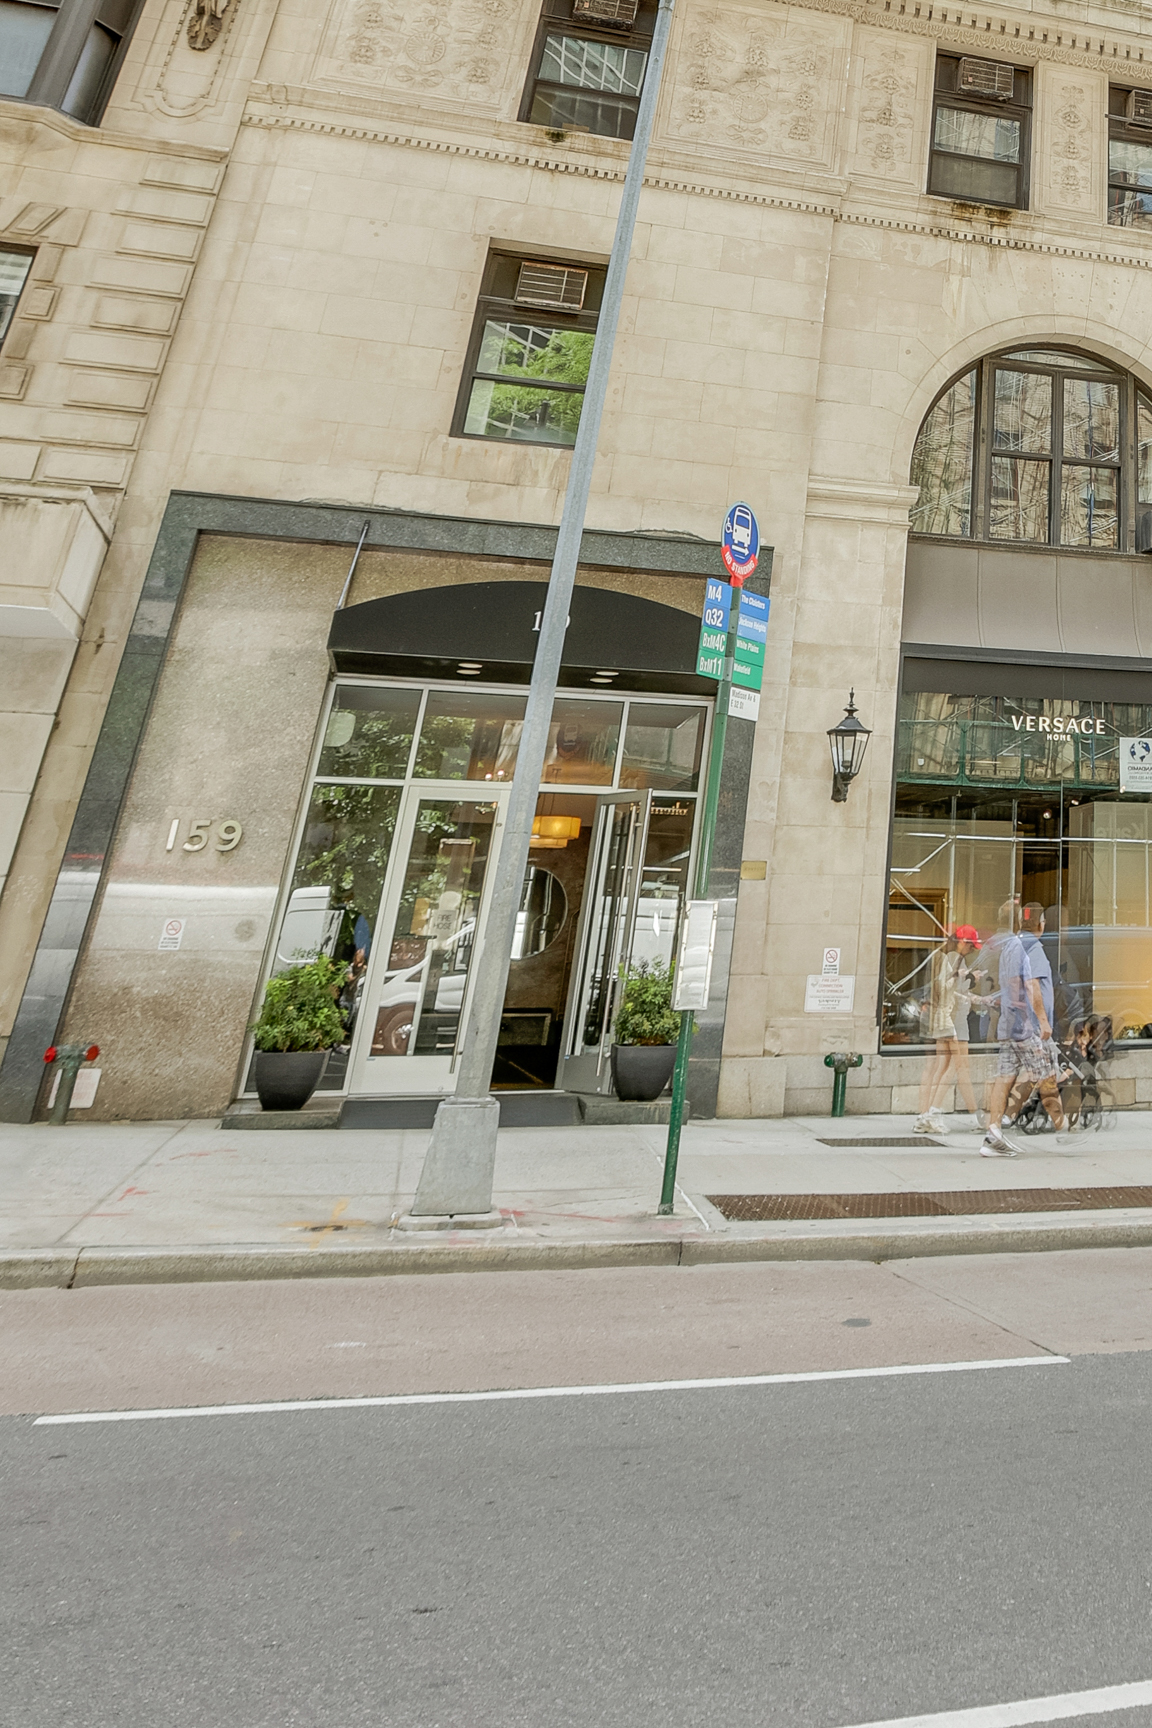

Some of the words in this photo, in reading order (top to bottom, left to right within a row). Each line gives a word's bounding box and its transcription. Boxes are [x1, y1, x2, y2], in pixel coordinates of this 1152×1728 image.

[725, 551, 733, 565] NO
[731, 559, 755, 575] STANDING
[707, 584, 722, 602] M4
[705, 608, 724, 627] Q32
[702, 632, 726, 652] BxM4C
[699, 656, 722, 676] BxM11
[1011, 715, 1106, 735] VERSACE
[166, 819, 243, 852] 159
[432, 923, 452, 931] HOSE
[437, 914, 452, 922] FIRE
